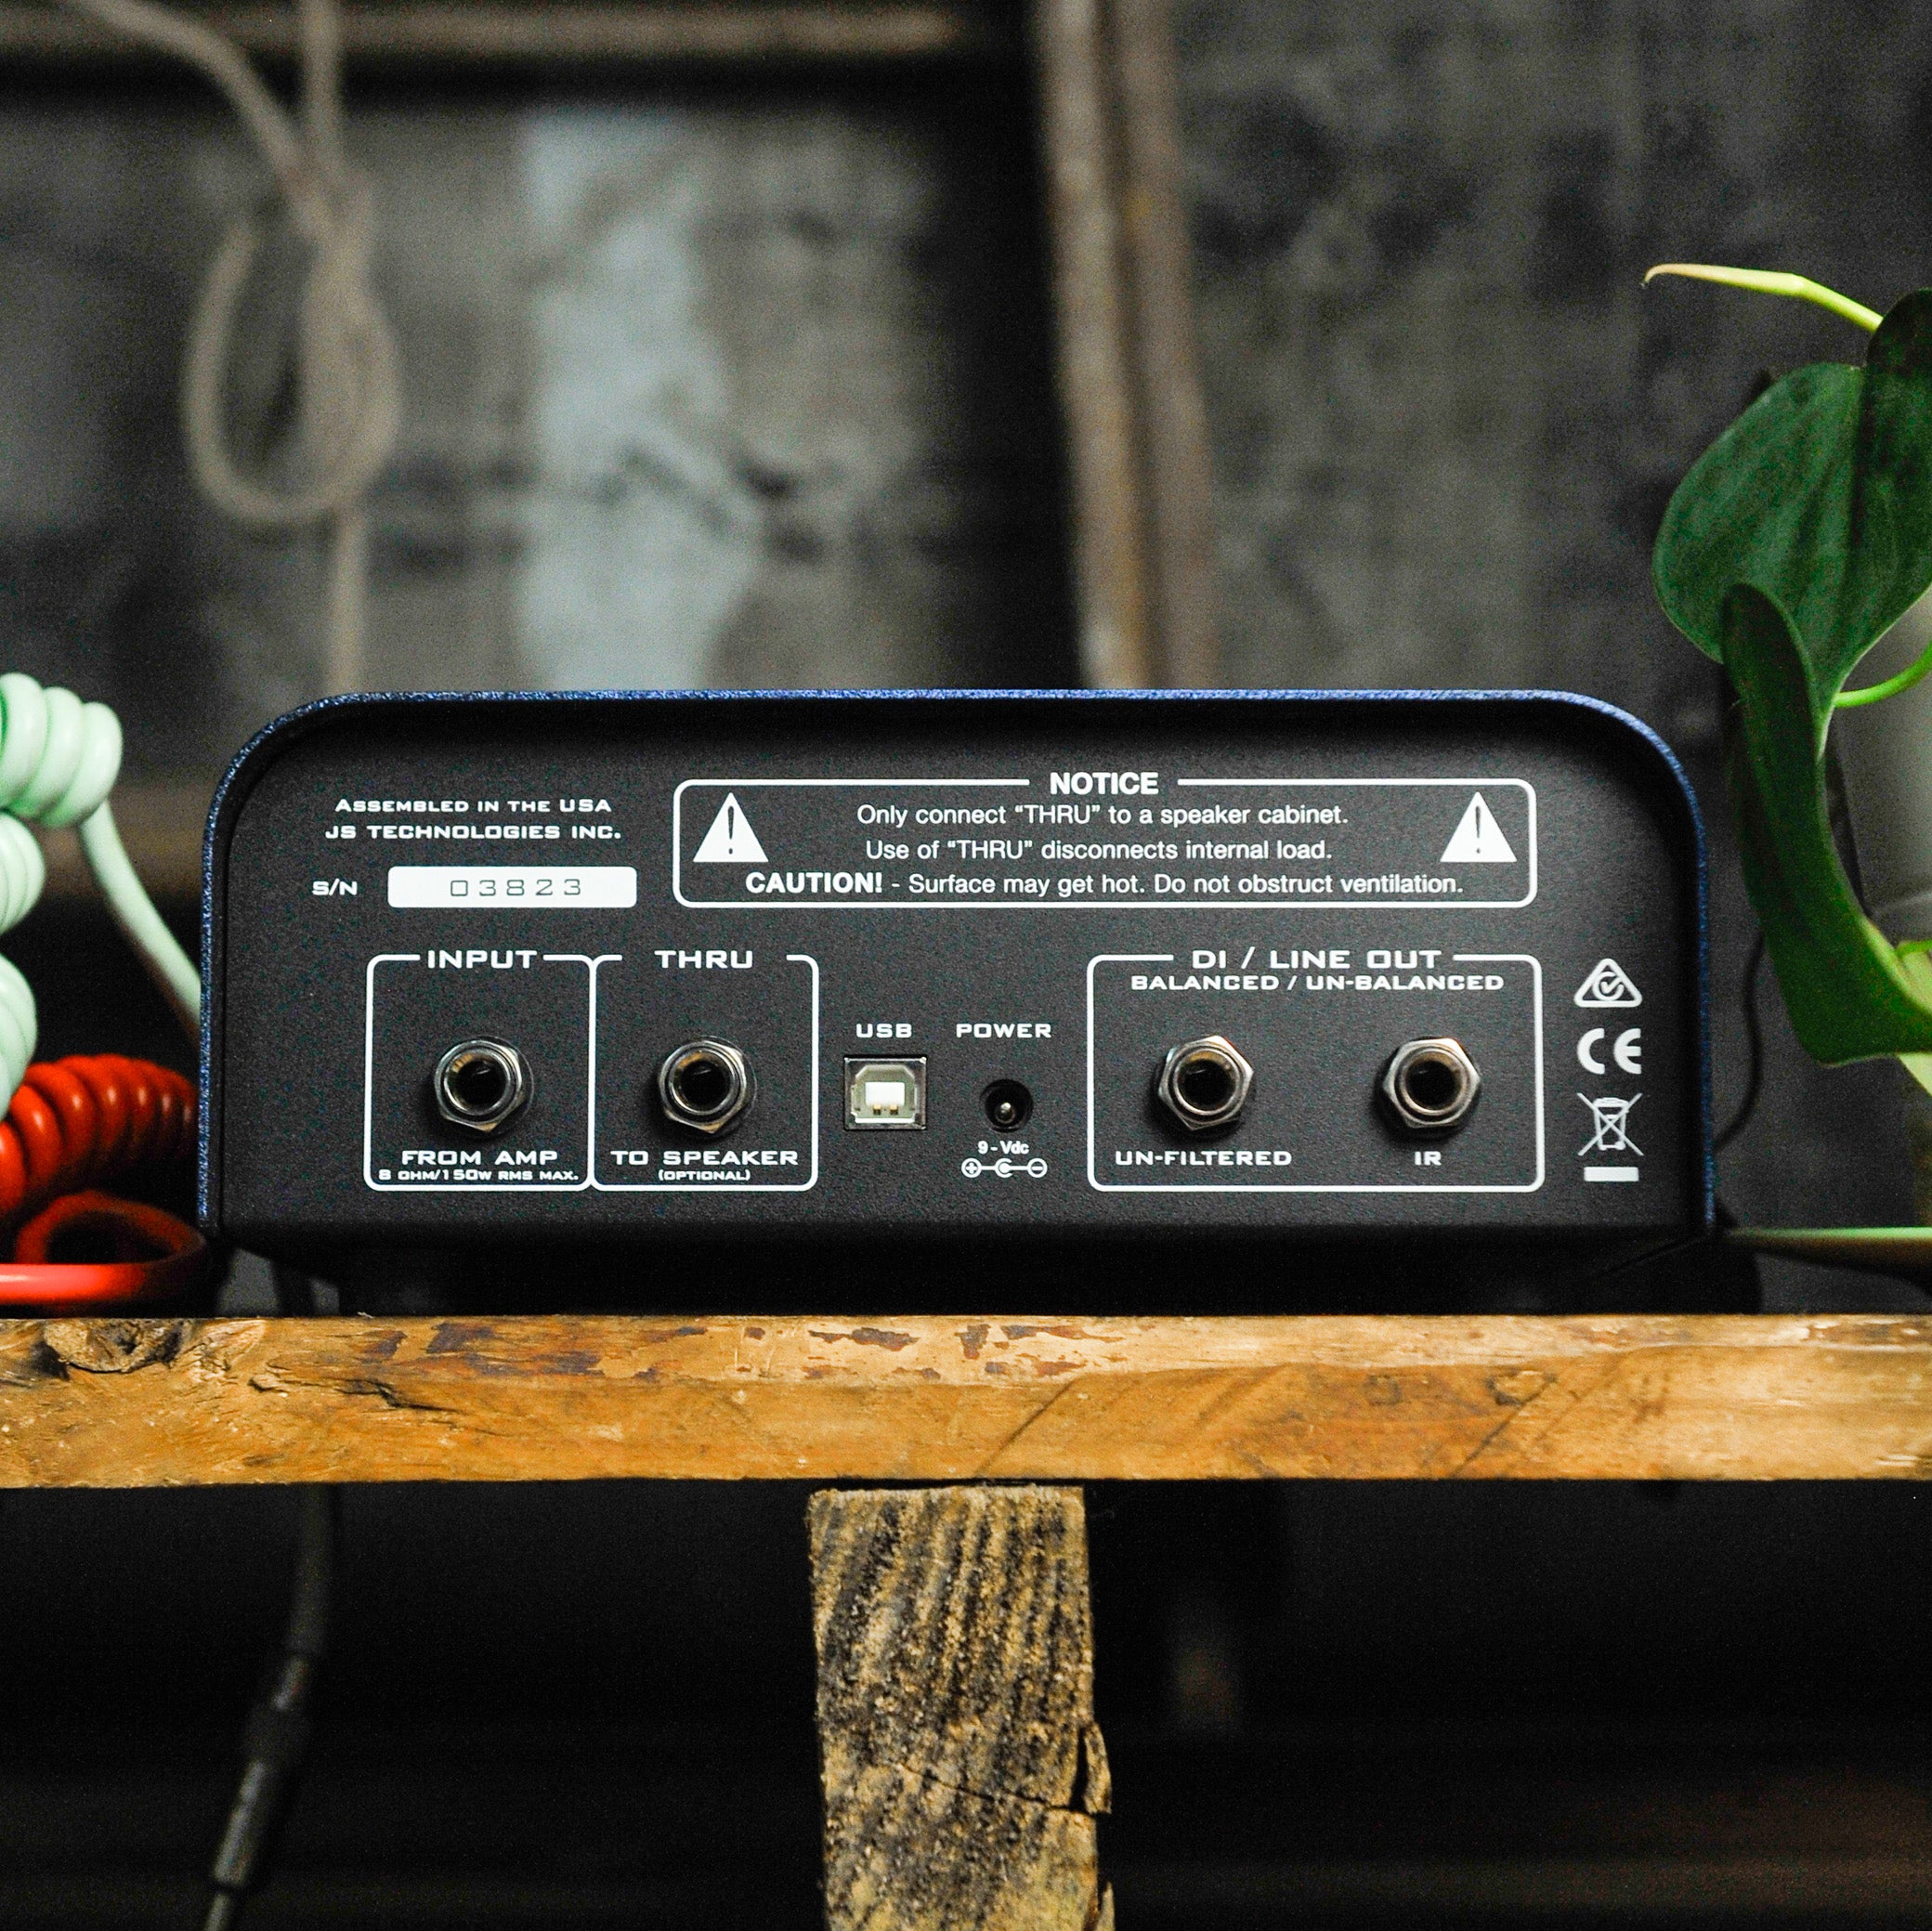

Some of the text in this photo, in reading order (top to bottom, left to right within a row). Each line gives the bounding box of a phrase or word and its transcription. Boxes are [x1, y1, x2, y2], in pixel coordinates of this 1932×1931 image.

[1050, 771, 1159, 795] NOTICE
[334, 798, 612, 813] ASSEMBLED IN THE USA
[856, 803, 908, 829] Only
[915, 805, 1007, 825] connect
[1107, 805, 1132, 825] to
[1139, 808, 1154, 825] a
[1160, 804, 1251, 829] speaker
[1258, 803, 1349, 825] cabinet.
[325, 825, 621, 840] JS TECHNOLOGIES INC.
[866, 840, 909, 860] Use
[917, 840, 940, 860] of
[1040, 840, 1179, 860] disconnects
[1185, 840, 1269, 860] internal
[1276, 840, 1332, 860] load.
[311, 878, 358, 896] S/N
[450, 878, 581, 897] 03823
[745, 871, 882, 894] CAUTION!
[908, 873, 996, 894] Surface
[1003, 878, 1051, 898] may
[1057, 874, 1094, 898] get
[1102, 873, 1145, 894] hot.
[1154, 873, 1186, 894] Do
[1194, 874, 1231, 894] not
[1237, 873, 1334, 894] obstruct
[1339, 873, 1464, 894] ventilation.
[427, 949, 538, 969] INPUT
[654, 949, 753, 969] THRU
[1192, 946, 1442, 970] DI / LINE OUT
[1130, 974, 1505, 991] BALANCED / UN-BALANCED
[855, 1023, 912, 1038] USB
[956, 1023, 1051, 1038] POWER
[1576, 1027, 1641, 1075] CE
[401, 1150, 558, 1166] FROM AMP
[610, 1150, 799, 1166] TO SPEAKER
[1115, 1150, 1292, 1166] UN-FILTERED
[1414, 1151, 1442, 1166] IR
[378, 1168, 392, 1181] 8
[498, 1170, 533, 1181] RMS
[539, 1170, 579, 1181] MAX.
[658, 1168, 751, 1181] (OPTIONAL)
